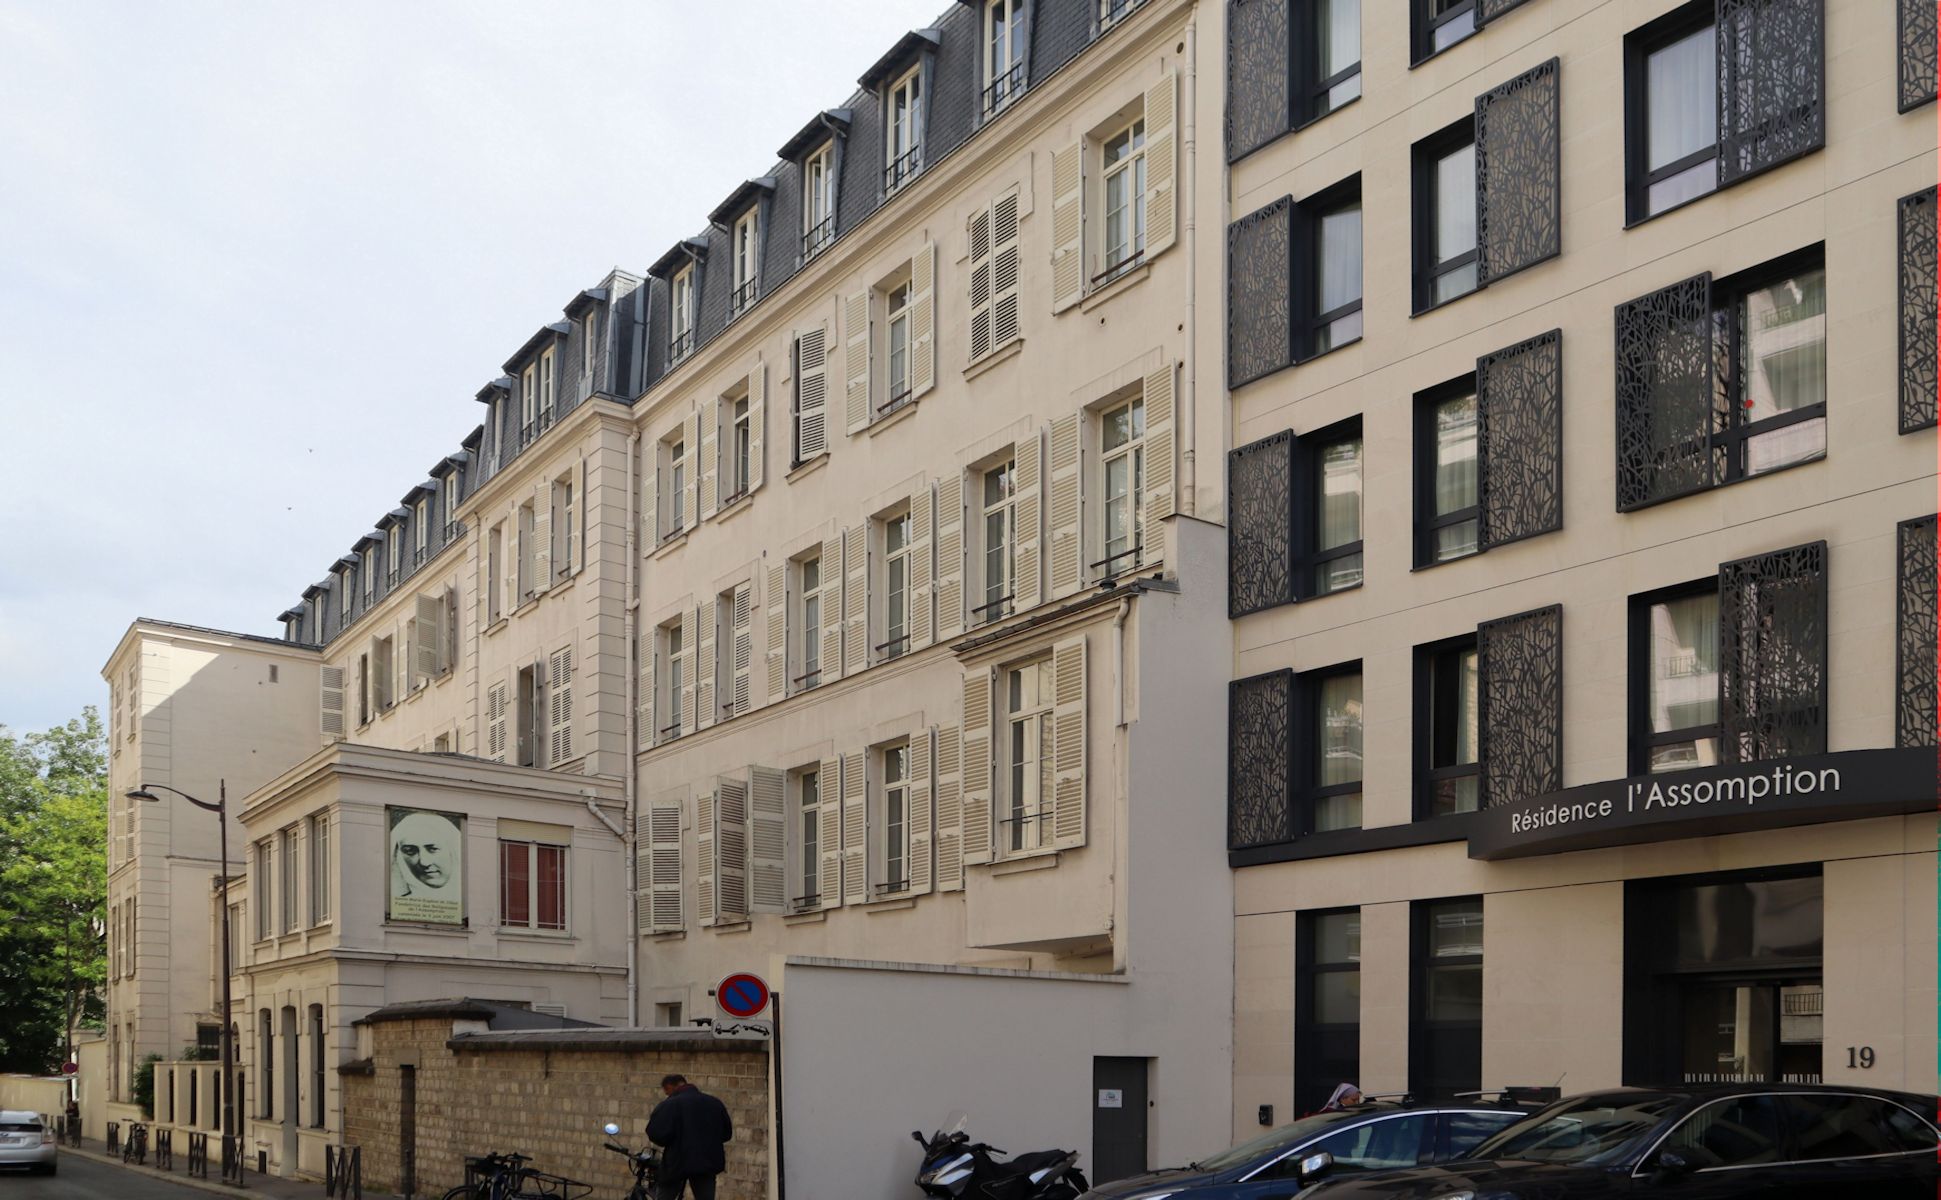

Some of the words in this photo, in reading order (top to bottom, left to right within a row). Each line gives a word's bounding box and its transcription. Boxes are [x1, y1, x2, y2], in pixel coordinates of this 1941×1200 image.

[1512, 799, 1613, 834] Résidence
[1628, 765, 1841, 812] l'Assomption
[1846, 1046, 1876, 1069] 19
